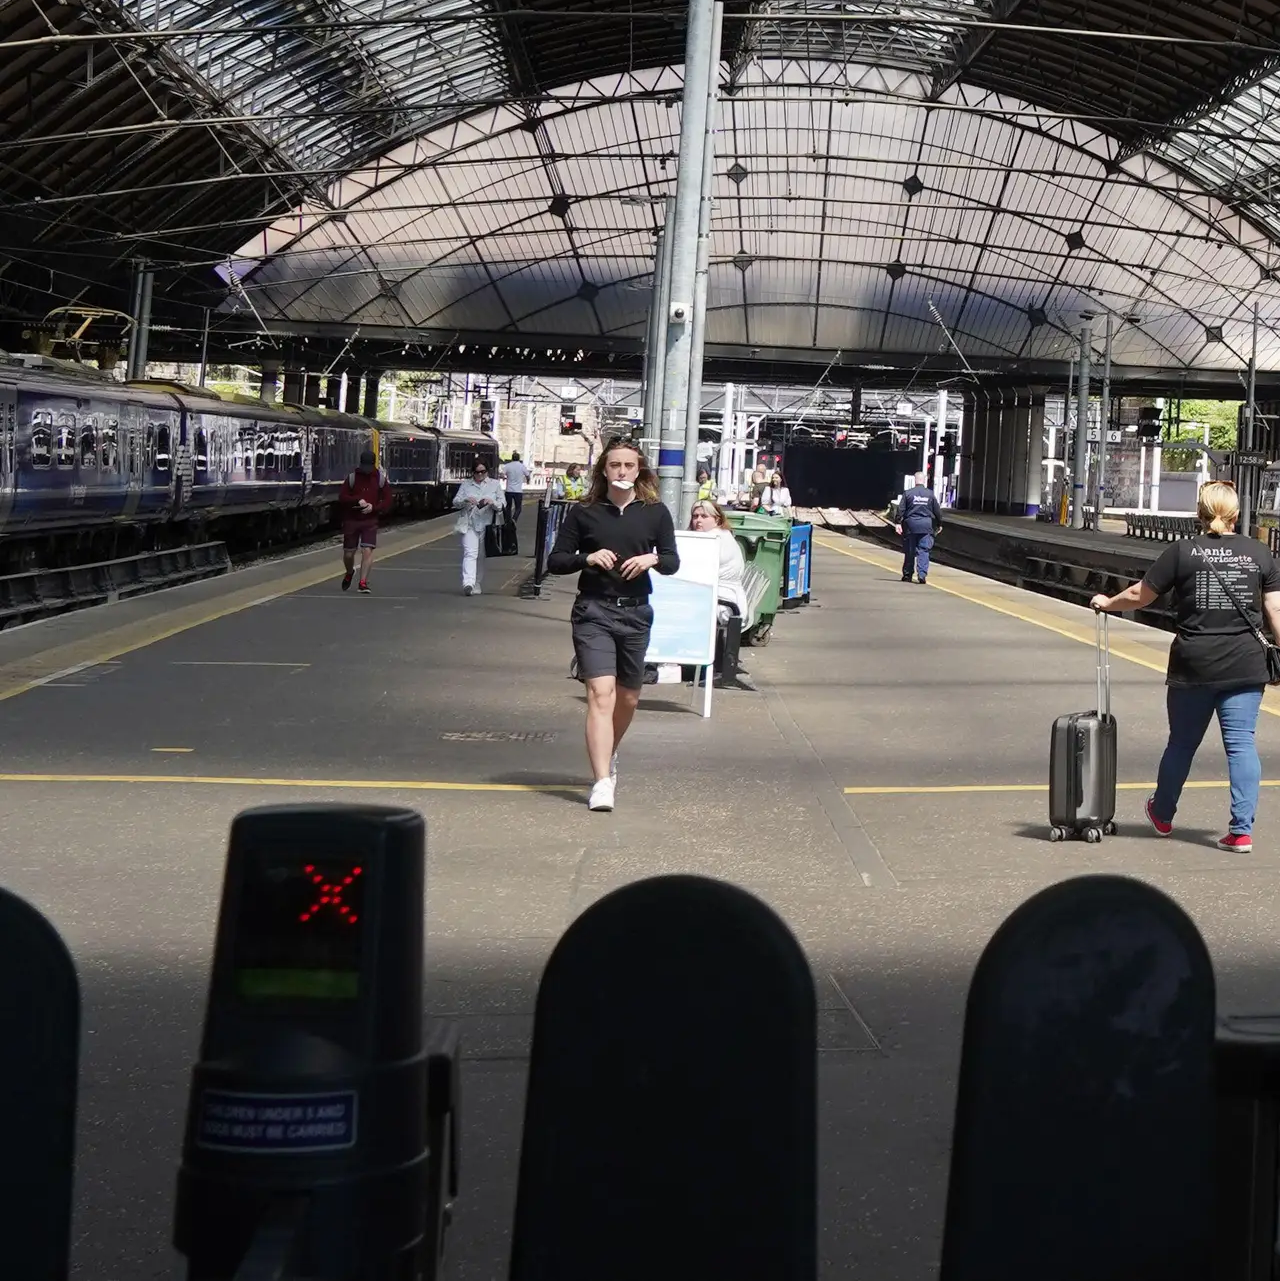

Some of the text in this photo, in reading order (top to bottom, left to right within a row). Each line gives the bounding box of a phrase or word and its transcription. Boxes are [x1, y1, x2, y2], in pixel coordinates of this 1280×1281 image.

[633, 409, 640, 418] 3
[1091, 431, 1097, 440] 5
[1111, 432, 1117, 441] 6
[1191, 547, 1233, 557] Aanis
[1203, 555, 1253, 563] orissette
[257, 1106, 304, 1121] UNDER
[231, 1124, 264, 1139] MUST
[265, 1125, 285, 1140] BE
[286, 1121, 347, 1139] CARRIED
